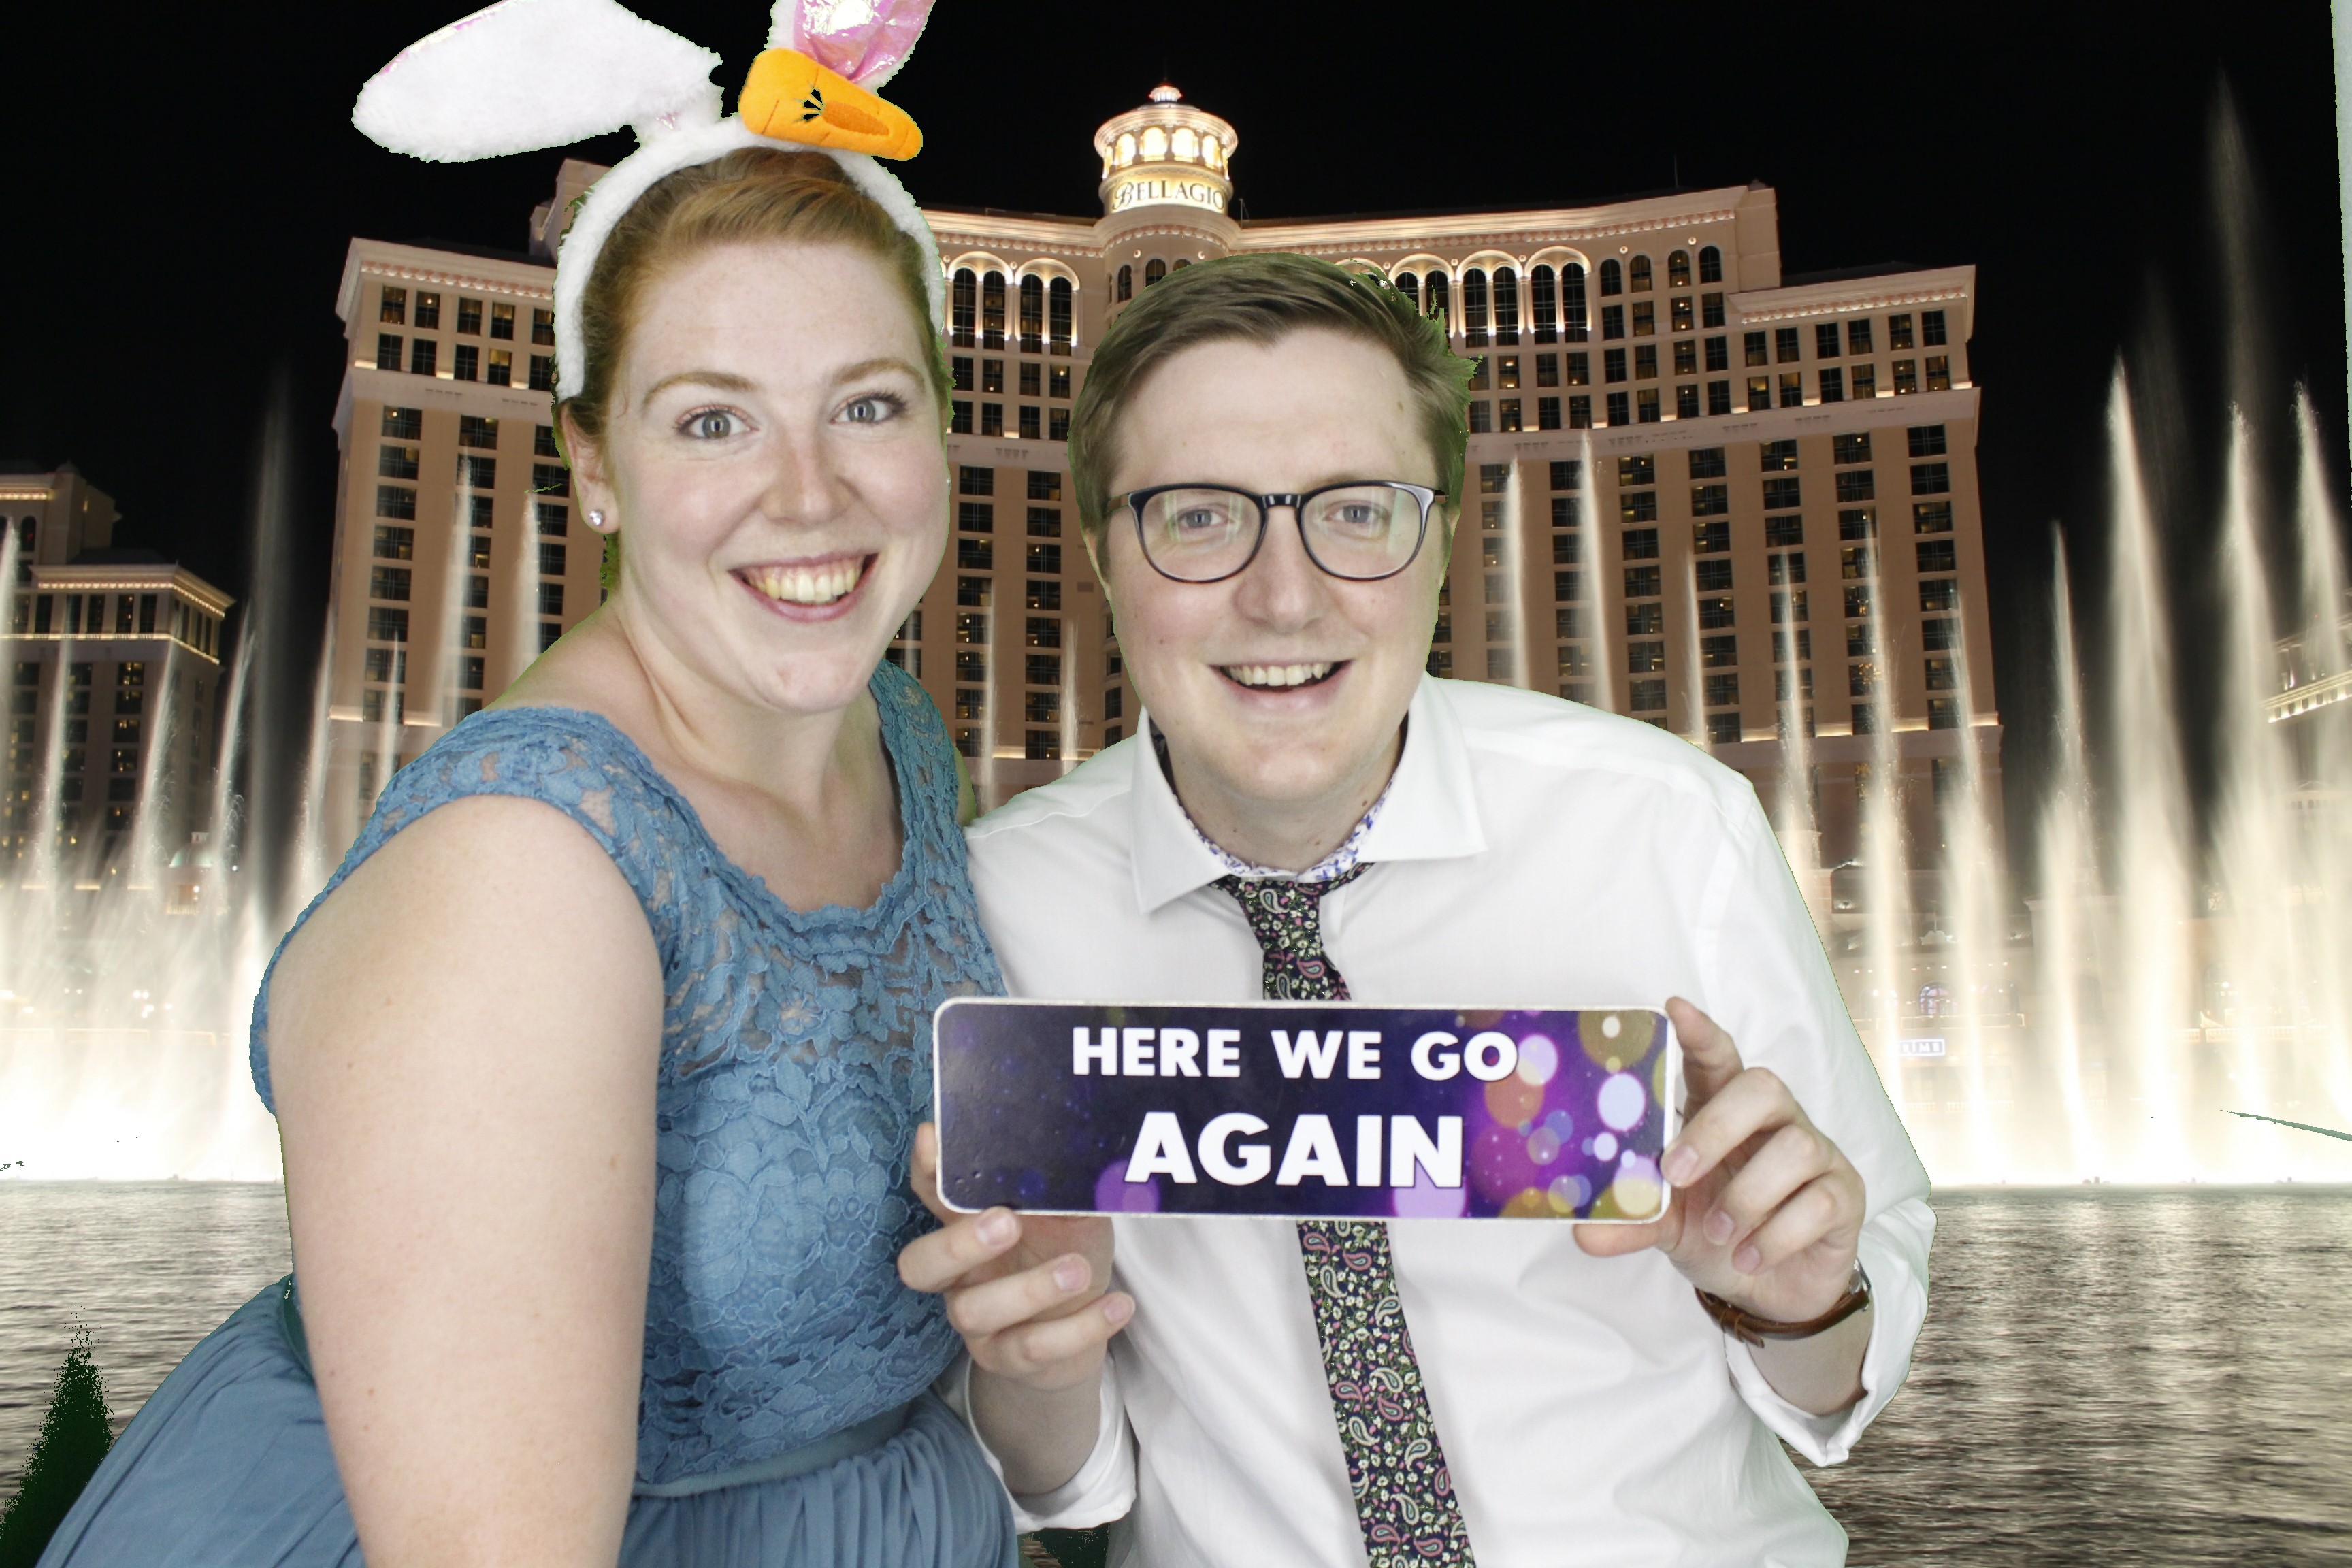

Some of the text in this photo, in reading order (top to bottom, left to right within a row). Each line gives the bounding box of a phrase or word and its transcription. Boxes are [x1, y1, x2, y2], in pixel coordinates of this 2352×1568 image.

[1111, 180, 1225, 210] BELLAGIO
[1073, 1026, 1518, 1081] HERE WE GO
[1896, 1042, 1940, 1054] RIME
[1124, 1111, 1463, 1188] AGAIN
